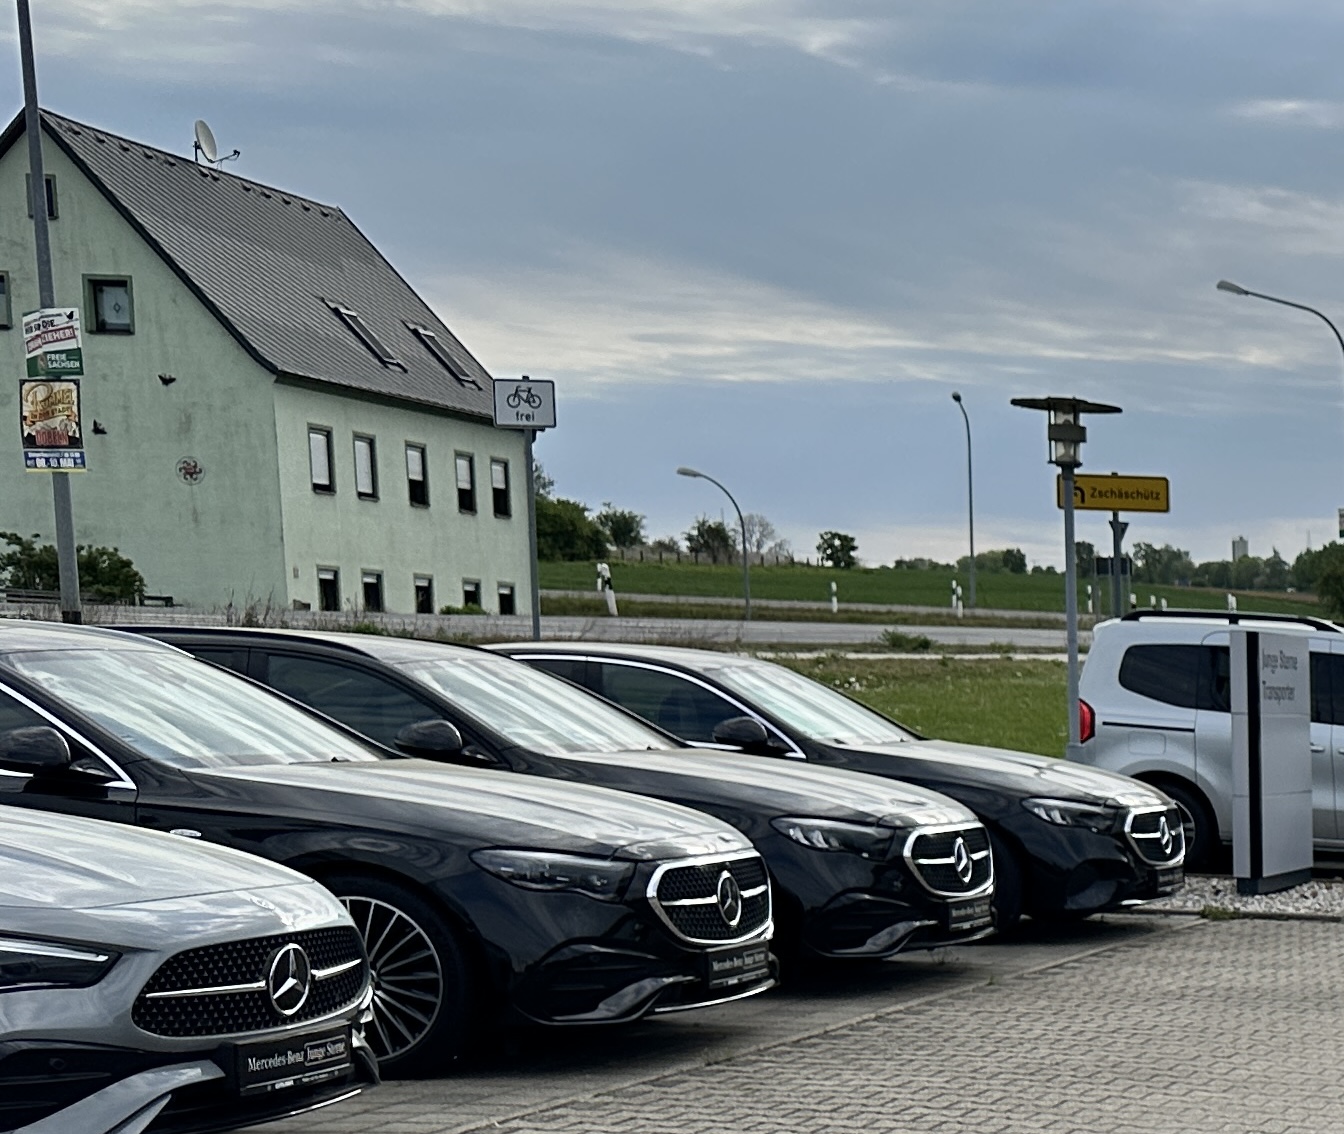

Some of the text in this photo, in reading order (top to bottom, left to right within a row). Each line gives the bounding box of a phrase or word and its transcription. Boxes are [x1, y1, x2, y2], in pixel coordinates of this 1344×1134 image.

[47, 360, 80, 369] SACHSEN
[516, 410, 535, 422] frei
[1090, 487, 1161, 501] Zschäschütz
[247, 1049, 304, 1073] Mercedes-Benz
